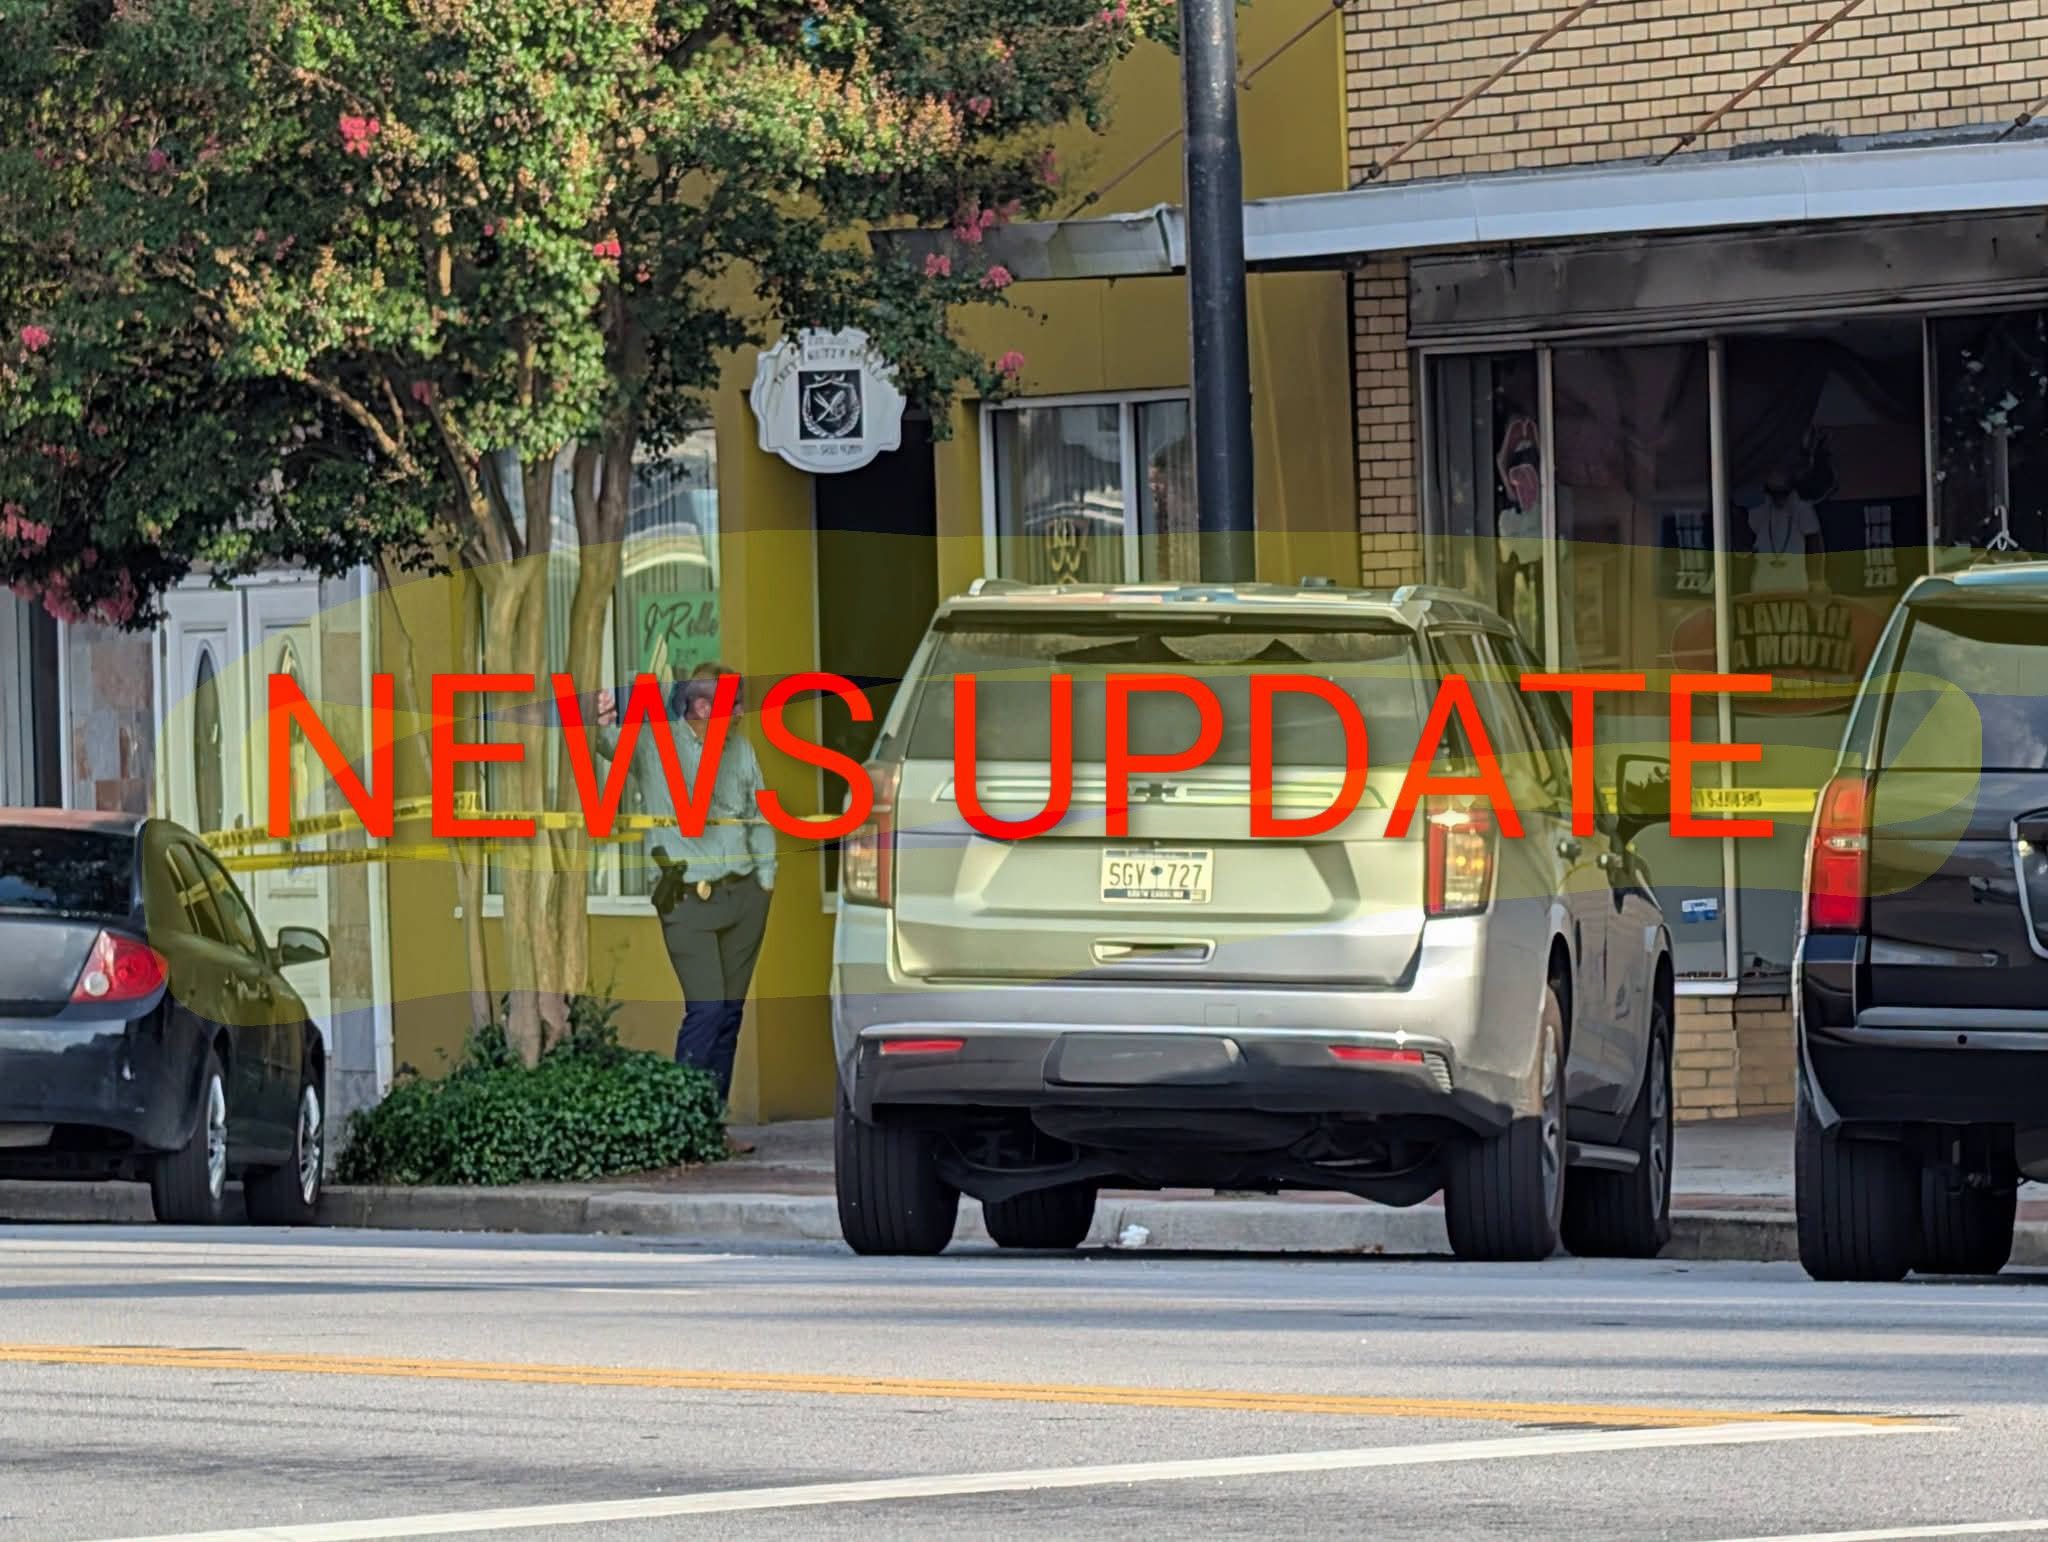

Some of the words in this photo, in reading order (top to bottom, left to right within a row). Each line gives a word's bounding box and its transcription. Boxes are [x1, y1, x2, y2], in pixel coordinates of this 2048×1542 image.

[1735, 601, 1810, 636] LAVA
[1734, 638, 1751, 669] A
[1755, 633, 1856, 673] MOUTH
[1109, 862, 1146, 887] SGV
[1167, 863, 1202, 888] 727
